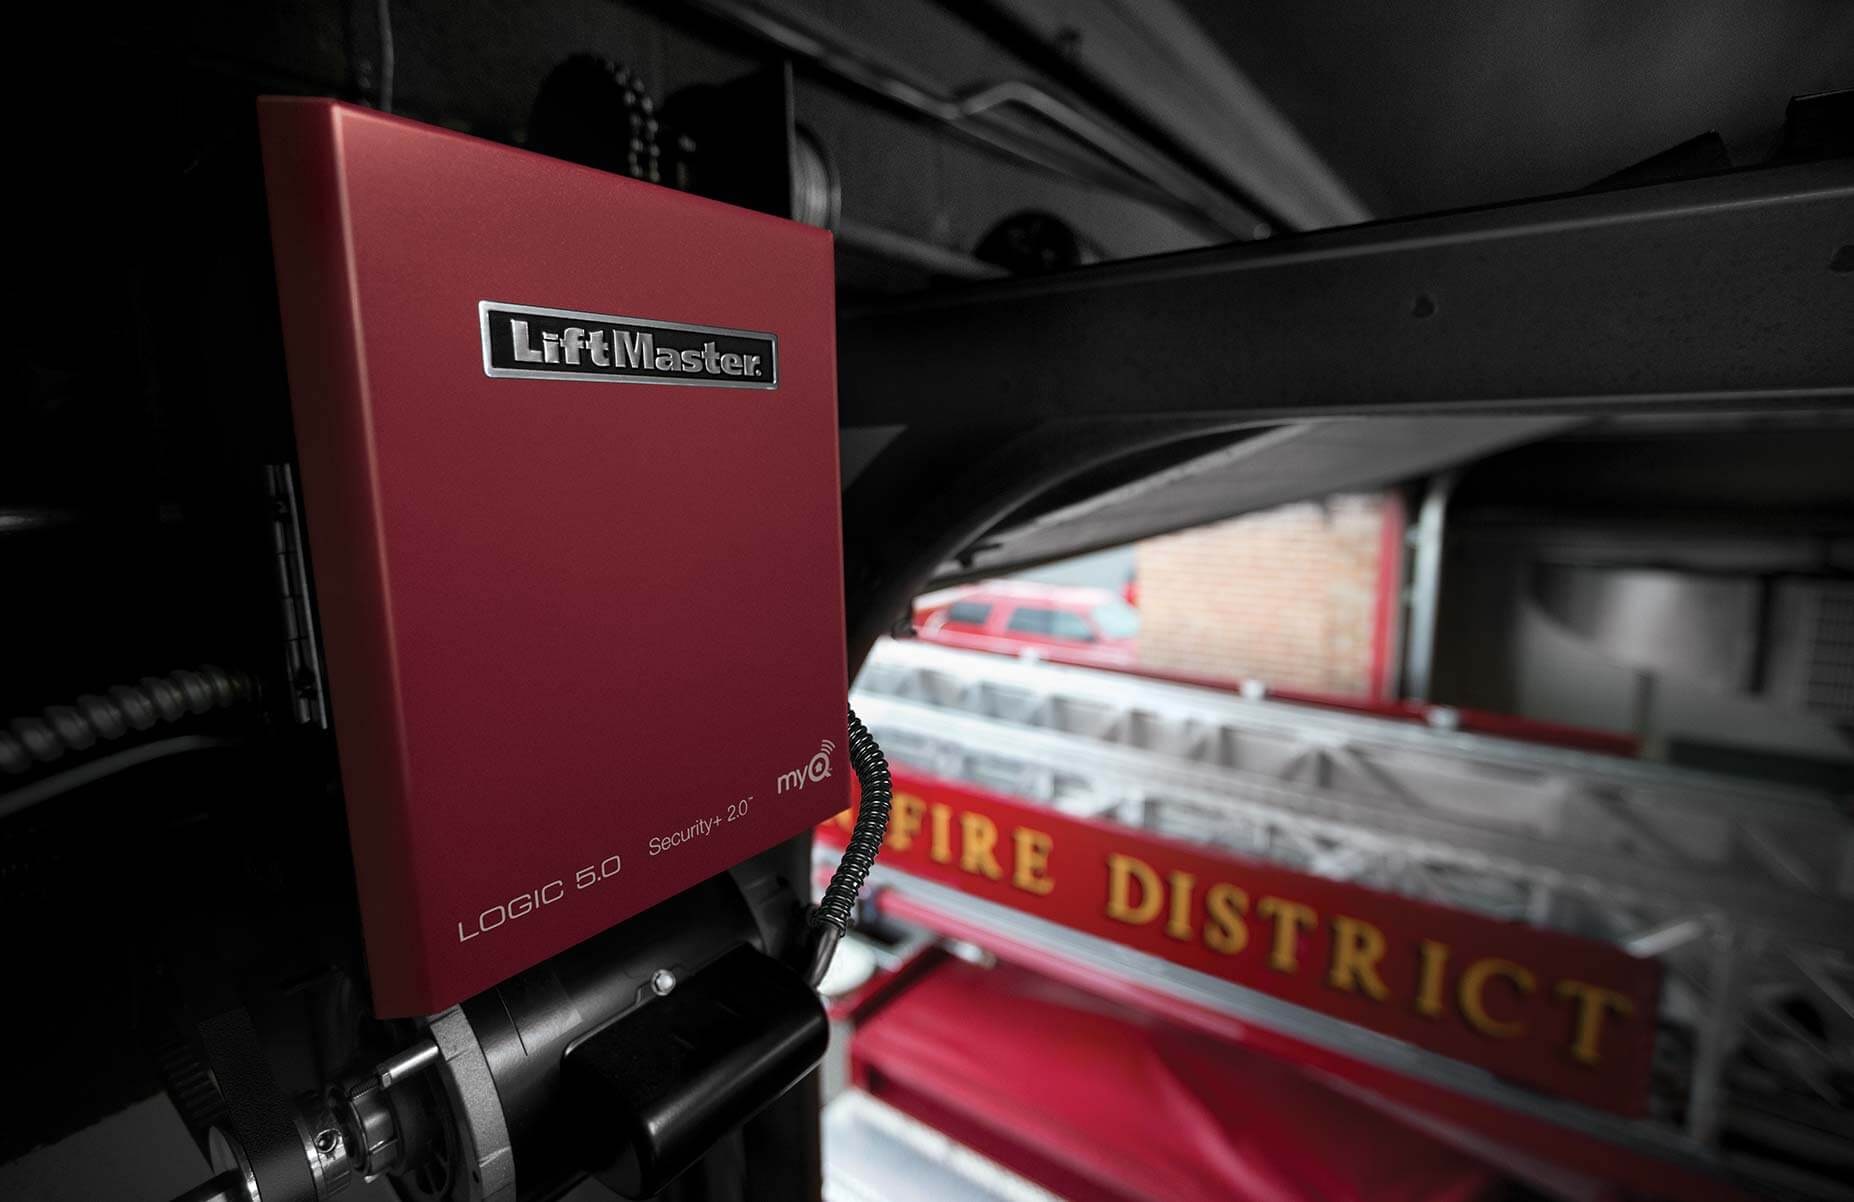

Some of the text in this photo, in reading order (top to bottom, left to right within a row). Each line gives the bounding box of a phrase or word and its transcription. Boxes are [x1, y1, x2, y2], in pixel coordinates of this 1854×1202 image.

[649, 815, 722, 856] Security+
[457, 855, 621, 943] LOGIC 5.0
[886, 793, 1635, 1066] FIRE DISTRICT
